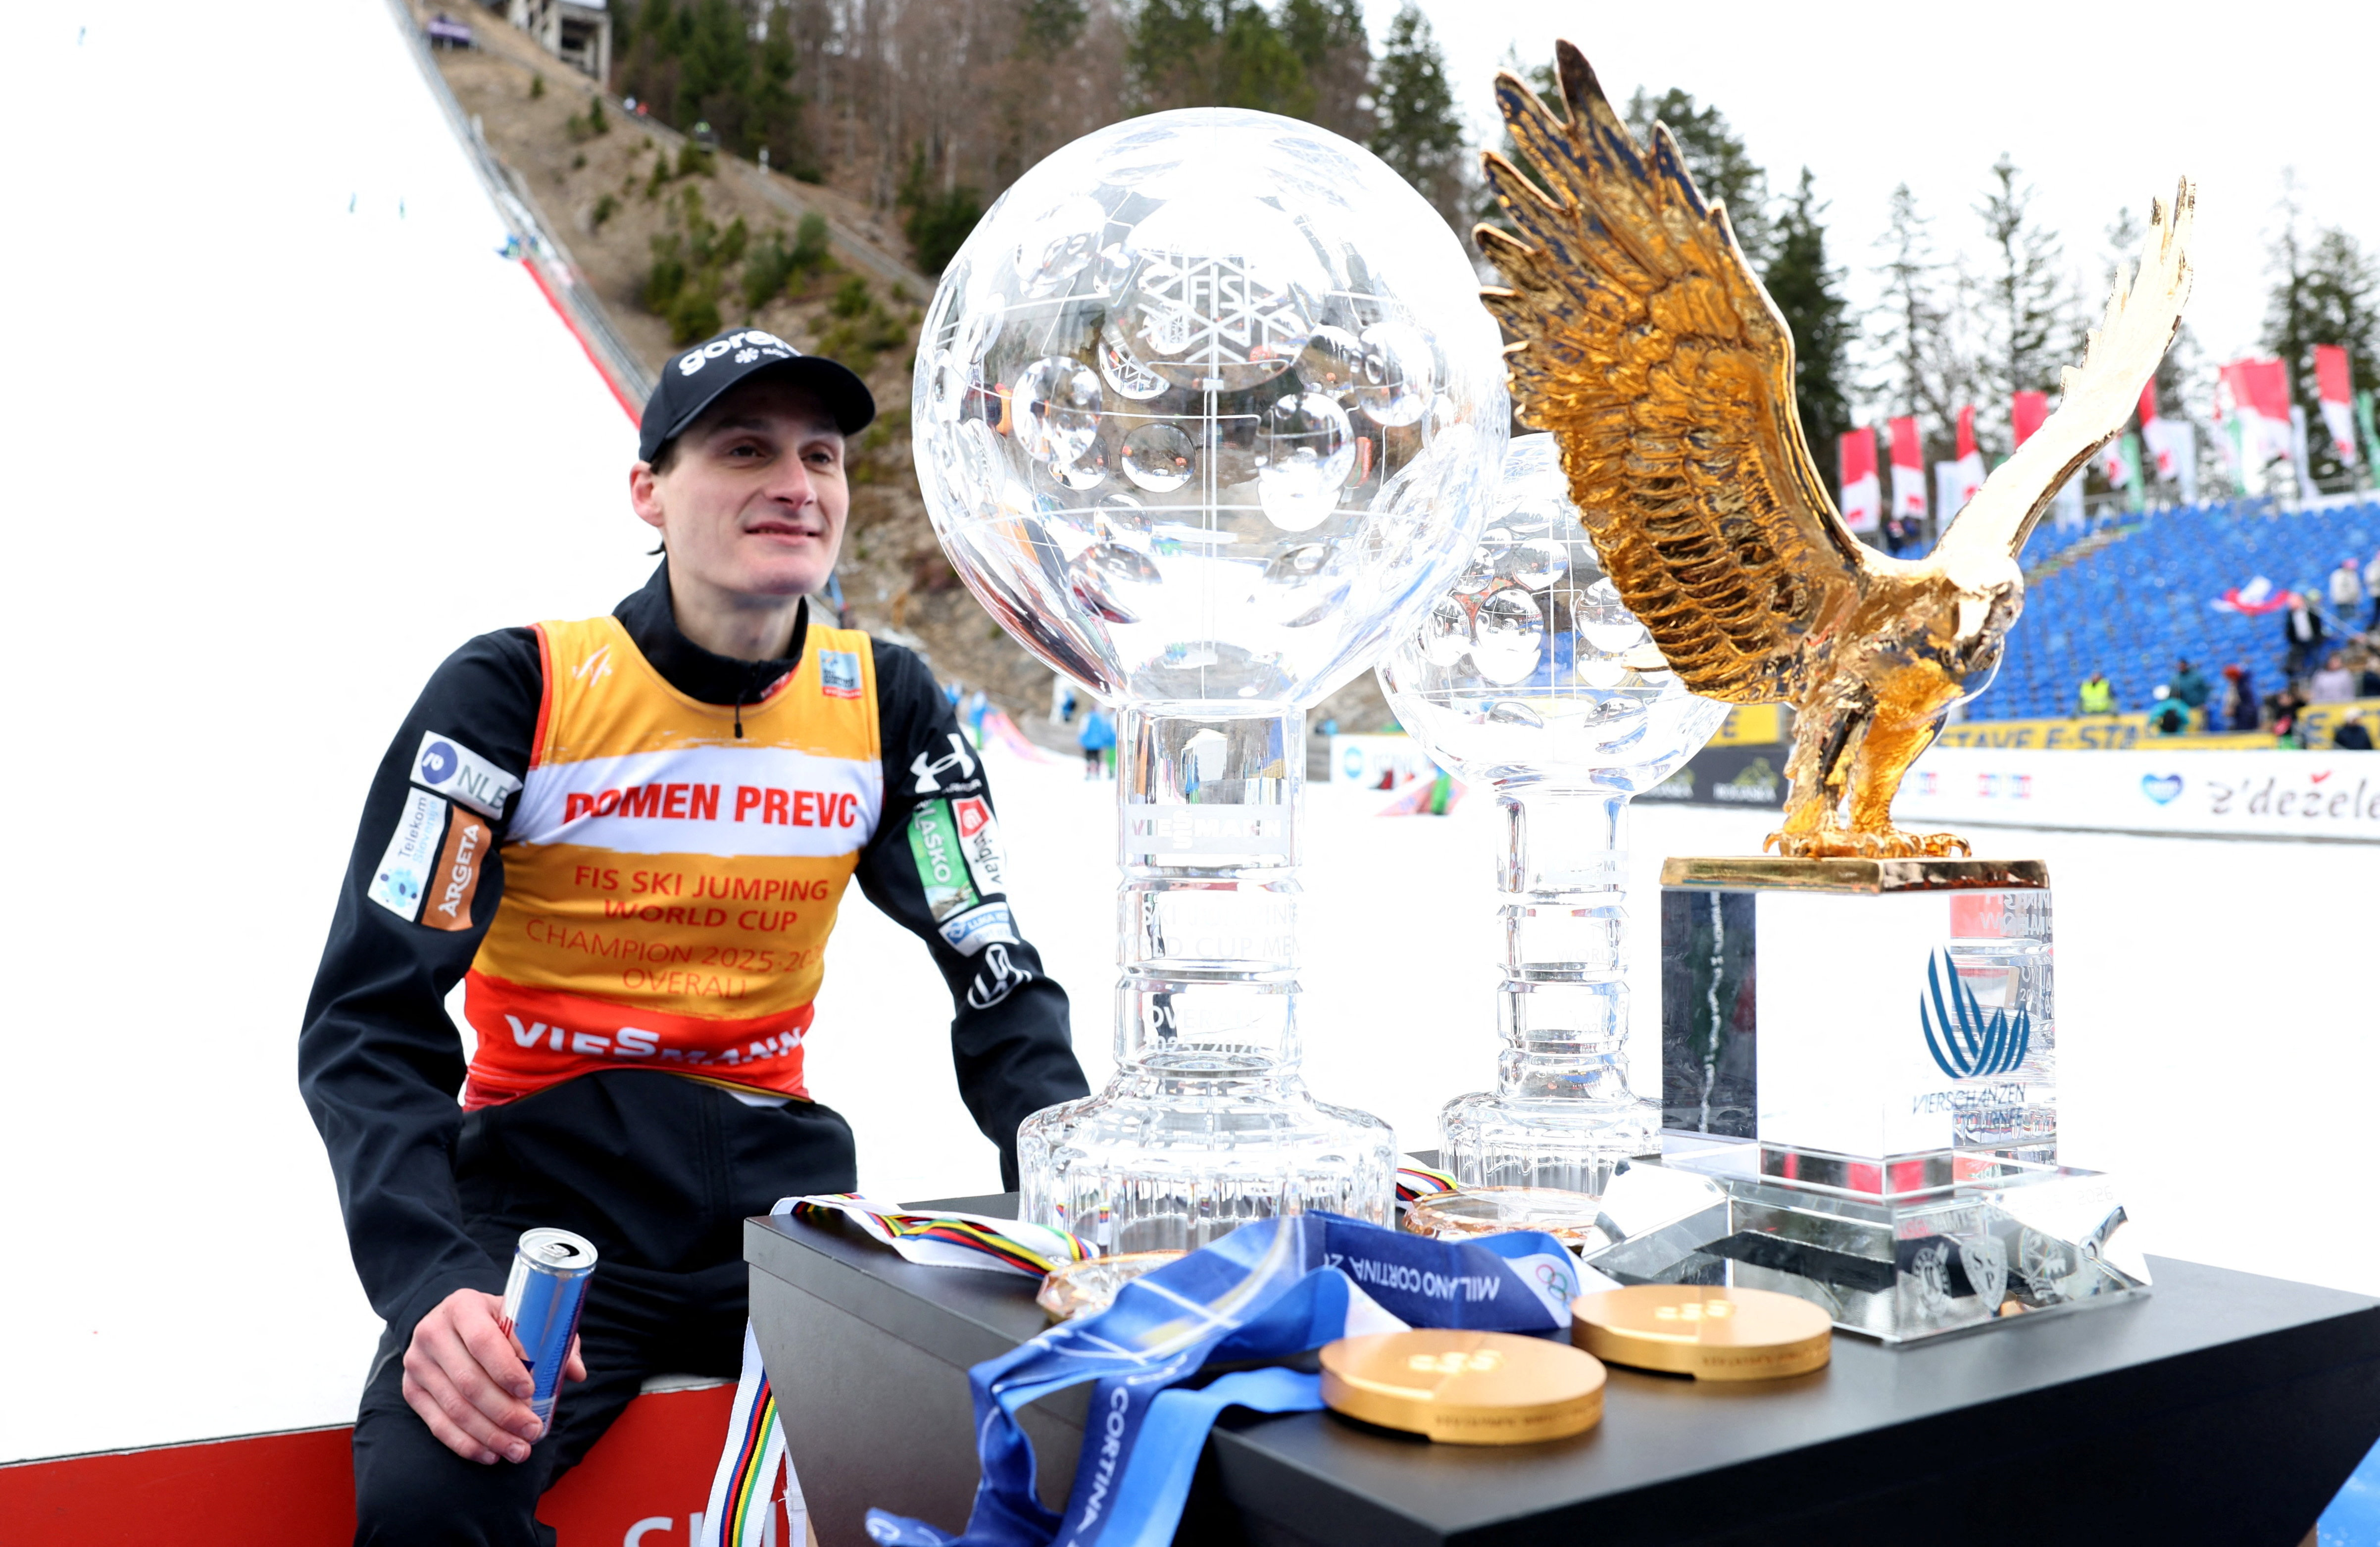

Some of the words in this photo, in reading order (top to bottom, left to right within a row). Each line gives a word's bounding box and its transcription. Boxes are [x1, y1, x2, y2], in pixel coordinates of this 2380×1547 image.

[398, 796, 427, 857] Telekom
[562, 783, 721, 825] DOMEN
[735, 785, 857, 828] PREVC
[413, 801, 438, 864] Slovenije
[438, 824, 480, 918] ARGETA
[574, 865, 619, 890] FIS
[631, 872, 682, 897] SKI
[693, 875, 830, 901] JUMPING
[603, 899, 727, 927] WORLD
[738, 909, 798, 932] CUP
[526, 919, 693, 964] CHAMPION
[622, 967, 748, 1000] OVERALL
[1348, 1256, 1421, 1293] CORTINA
[1422, 1271, 1500, 1302] MILANO
[1075, 1387, 1129, 1534] CORTINA
